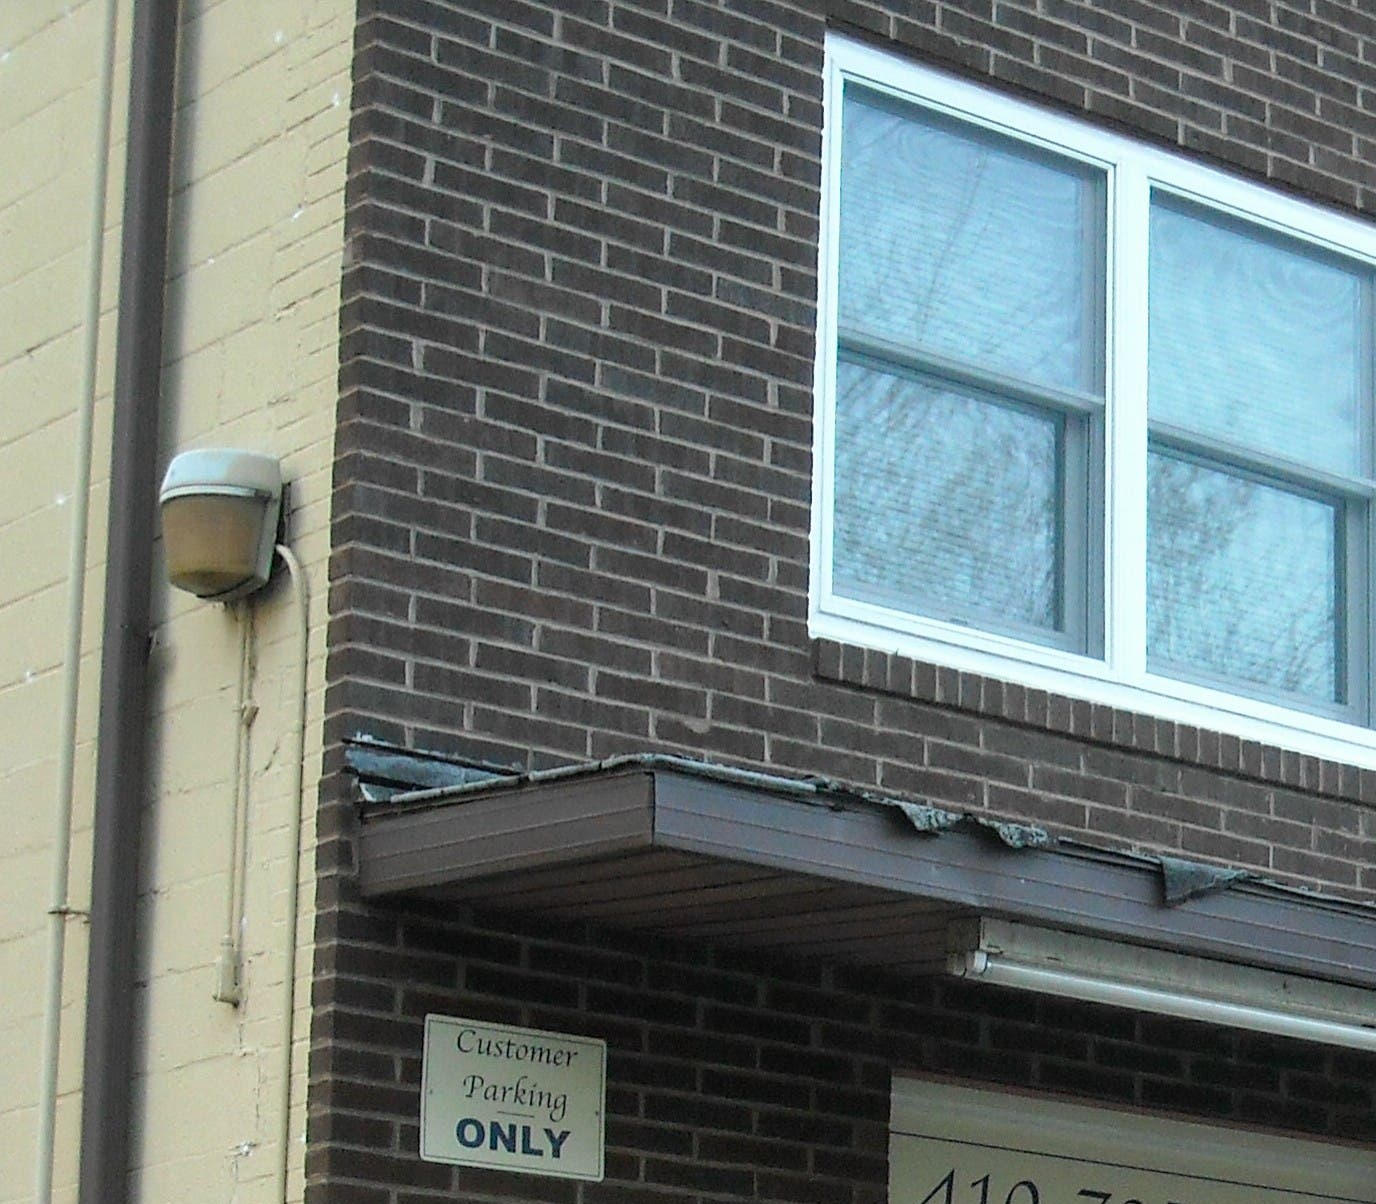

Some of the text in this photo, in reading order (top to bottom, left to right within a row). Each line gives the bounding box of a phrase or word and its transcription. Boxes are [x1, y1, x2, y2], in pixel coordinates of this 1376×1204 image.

[457, 1029, 578, 1067] Customer
[463, 1074, 567, 1122] Parking
[456, 1118, 571, 1158] ONLY
